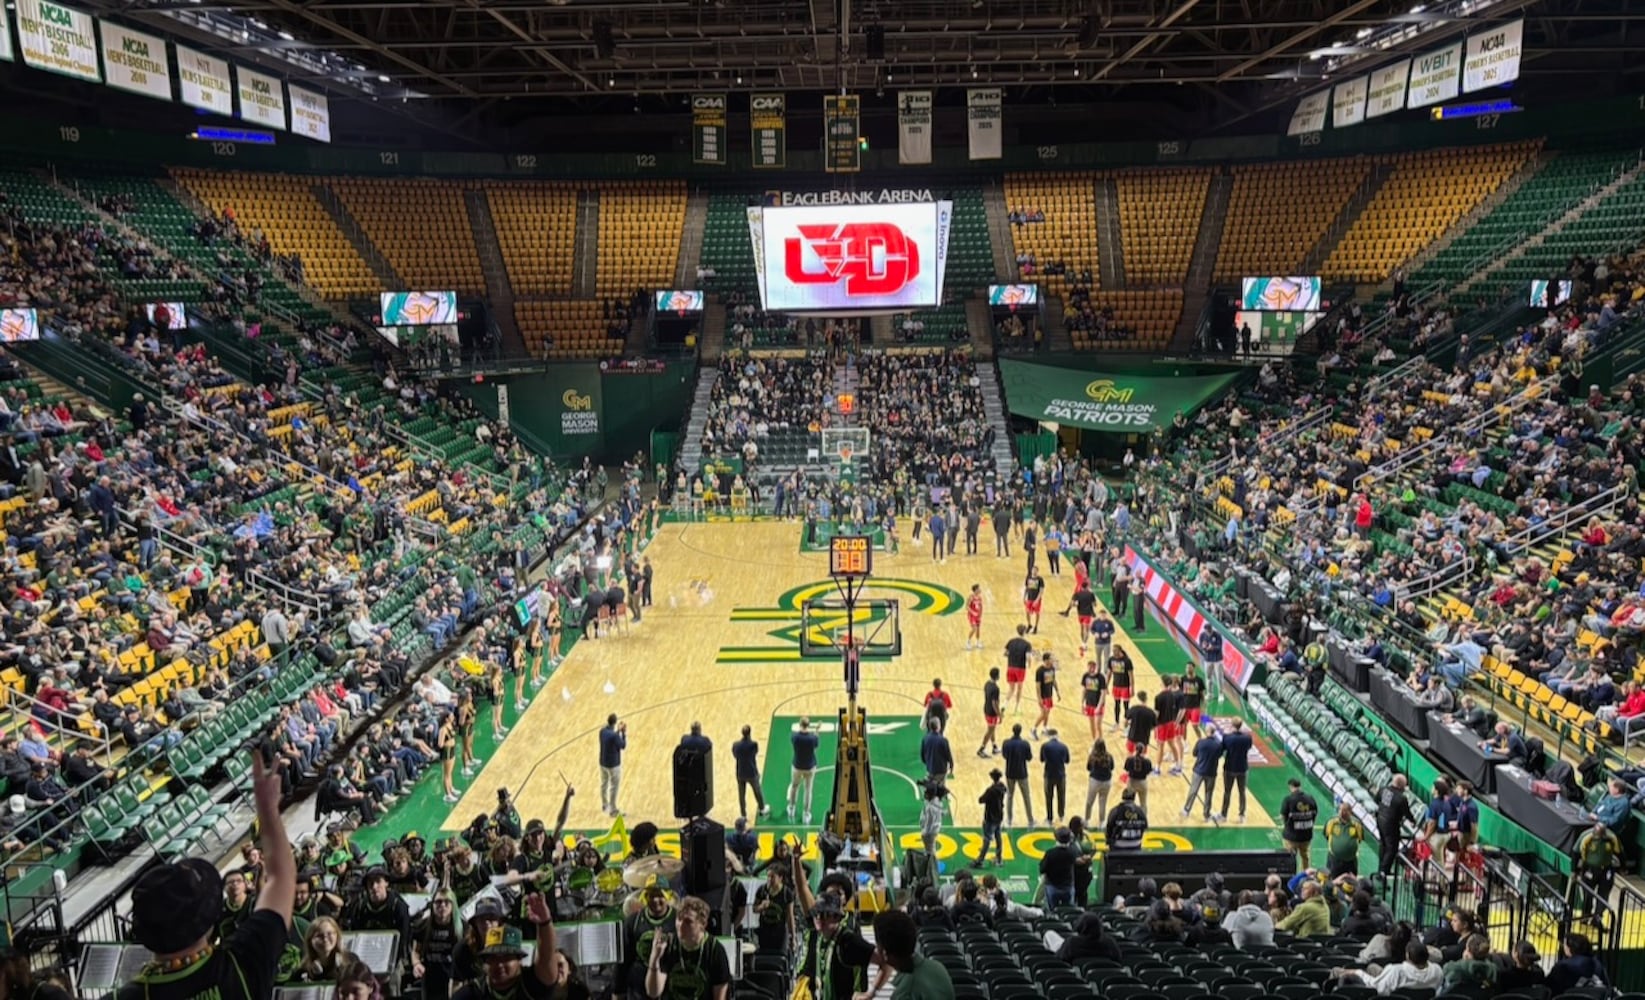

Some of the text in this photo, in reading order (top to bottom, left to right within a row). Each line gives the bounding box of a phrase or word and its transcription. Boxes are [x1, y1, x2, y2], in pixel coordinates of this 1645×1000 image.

[38, 3, 72, 28] NCAA
[44, 24, 93, 51] BASKETBALL
[1480, 32, 1505, 54] NCAA
[122, 36, 149, 58] NCAA
[106, 48, 166, 76] MEN'S BASKETBALL
[1420, 50, 1454, 74] WBIT
[1488, 46, 1521, 66] BASKETBALL
[251, 78, 270, 94] NCAA
[694, 97, 723, 108] CAA
[1475, 114, 1499, 129] 127
[59, 126, 80, 142] 119
[1300, 133, 1321, 146] 126
[211, 142, 236, 155] 120
[1037, 146, 1057, 158] 125
[1158, 142, 1179, 154] 125
[379, 152, 399, 164] 121
[516, 155, 537, 167] 122
[636, 154, 656, 166] 122
[938, 225, 947, 260] Inova
[1051, 399, 1103, 411] GEORGE
[561, 412, 597, 420] GEORGE
[561, 420, 598, 429] MASON
[833, 539, 868, 550] 20:00
